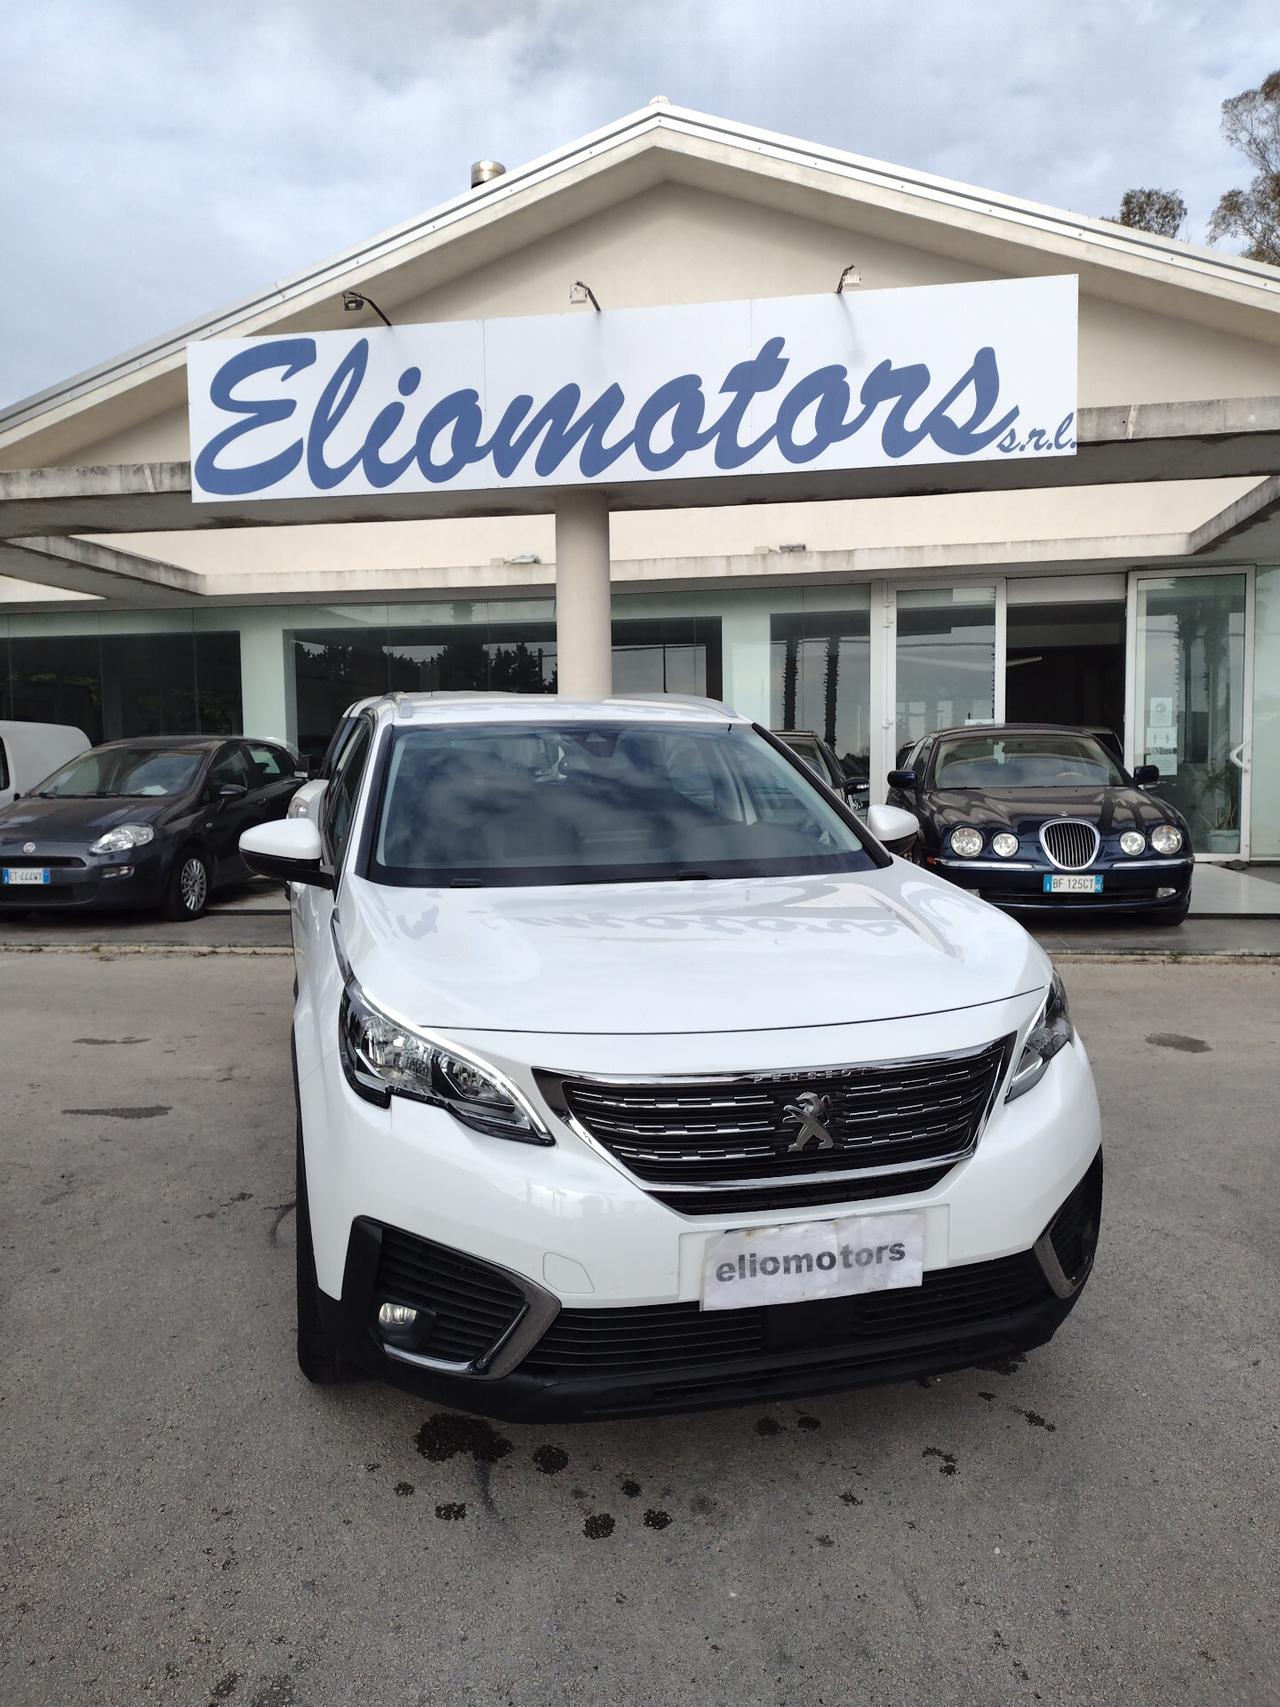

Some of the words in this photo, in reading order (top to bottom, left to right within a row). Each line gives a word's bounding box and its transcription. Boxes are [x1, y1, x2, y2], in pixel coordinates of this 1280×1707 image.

[195, 336, 1020, 496] Eliomotors
[997, 412, 1076, 453] s.r.l.
[1053, 877, 1064, 889] BF
[715, 1242, 906, 1283] eliomotors
